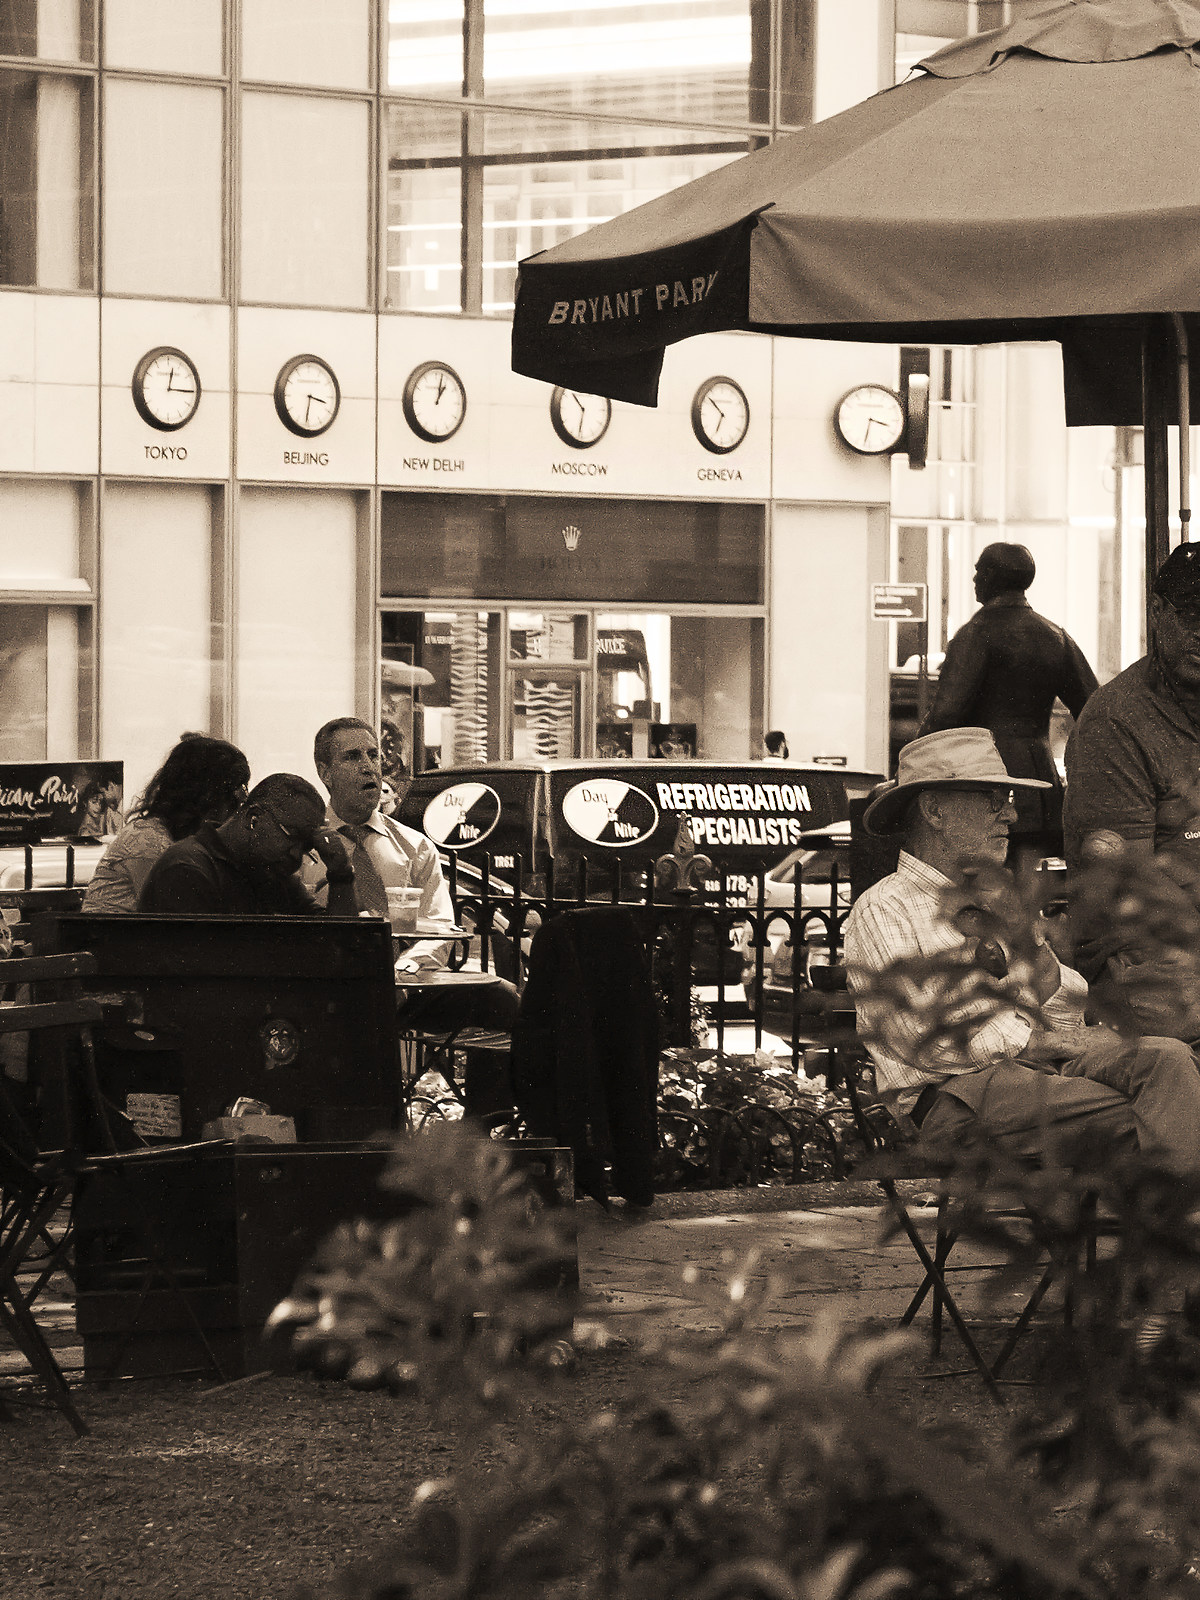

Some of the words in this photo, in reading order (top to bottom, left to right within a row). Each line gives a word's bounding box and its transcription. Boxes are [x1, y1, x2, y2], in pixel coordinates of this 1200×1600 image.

[548, 288, 644, 325] BRYANT
[144, 446, 188, 460] TOKYO
[283, 451, 329, 466] BEIJING
[402, 457, 430, 471] NEW
[433, 458, 465, 472] DELHI
[551, 462, 609, 476] MOSCOW
[697, 468, 743, 482] GENEVA
[443, 793, 465, 808] Day
[582, 788, 608, 805] Day
[656, 783, 812, 812] REFRIGERATION
[607, 807, 619, 822] &
[459, 823, 481, 840] Nile
[614, 821, 641, 839] Nile
